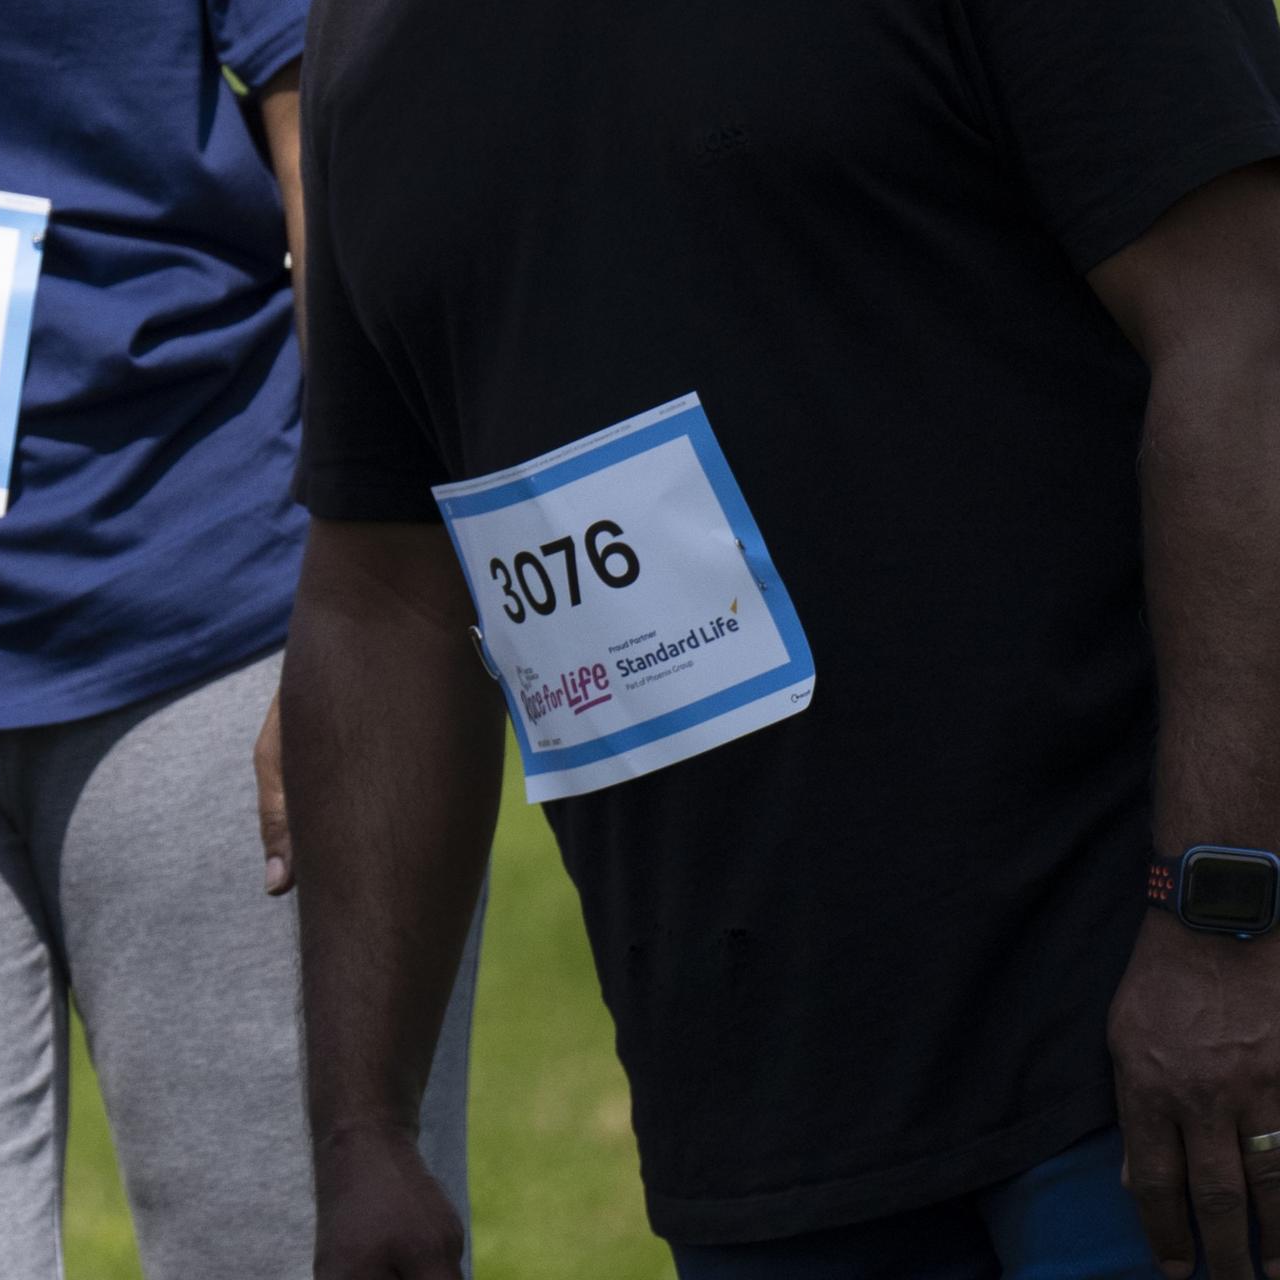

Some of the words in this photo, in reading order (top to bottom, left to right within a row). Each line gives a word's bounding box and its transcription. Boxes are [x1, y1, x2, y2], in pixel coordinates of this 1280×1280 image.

[489, 519, 641, 624] 3076
[608, 640, 629, 654] Proud
[629, 630, 657, 646] Partner
[616, 629, 700, 678] Standard
[698, 616, 740, 644] Life
[542, 684, 565, 712] for
[561, 663, 610, 708] Life
